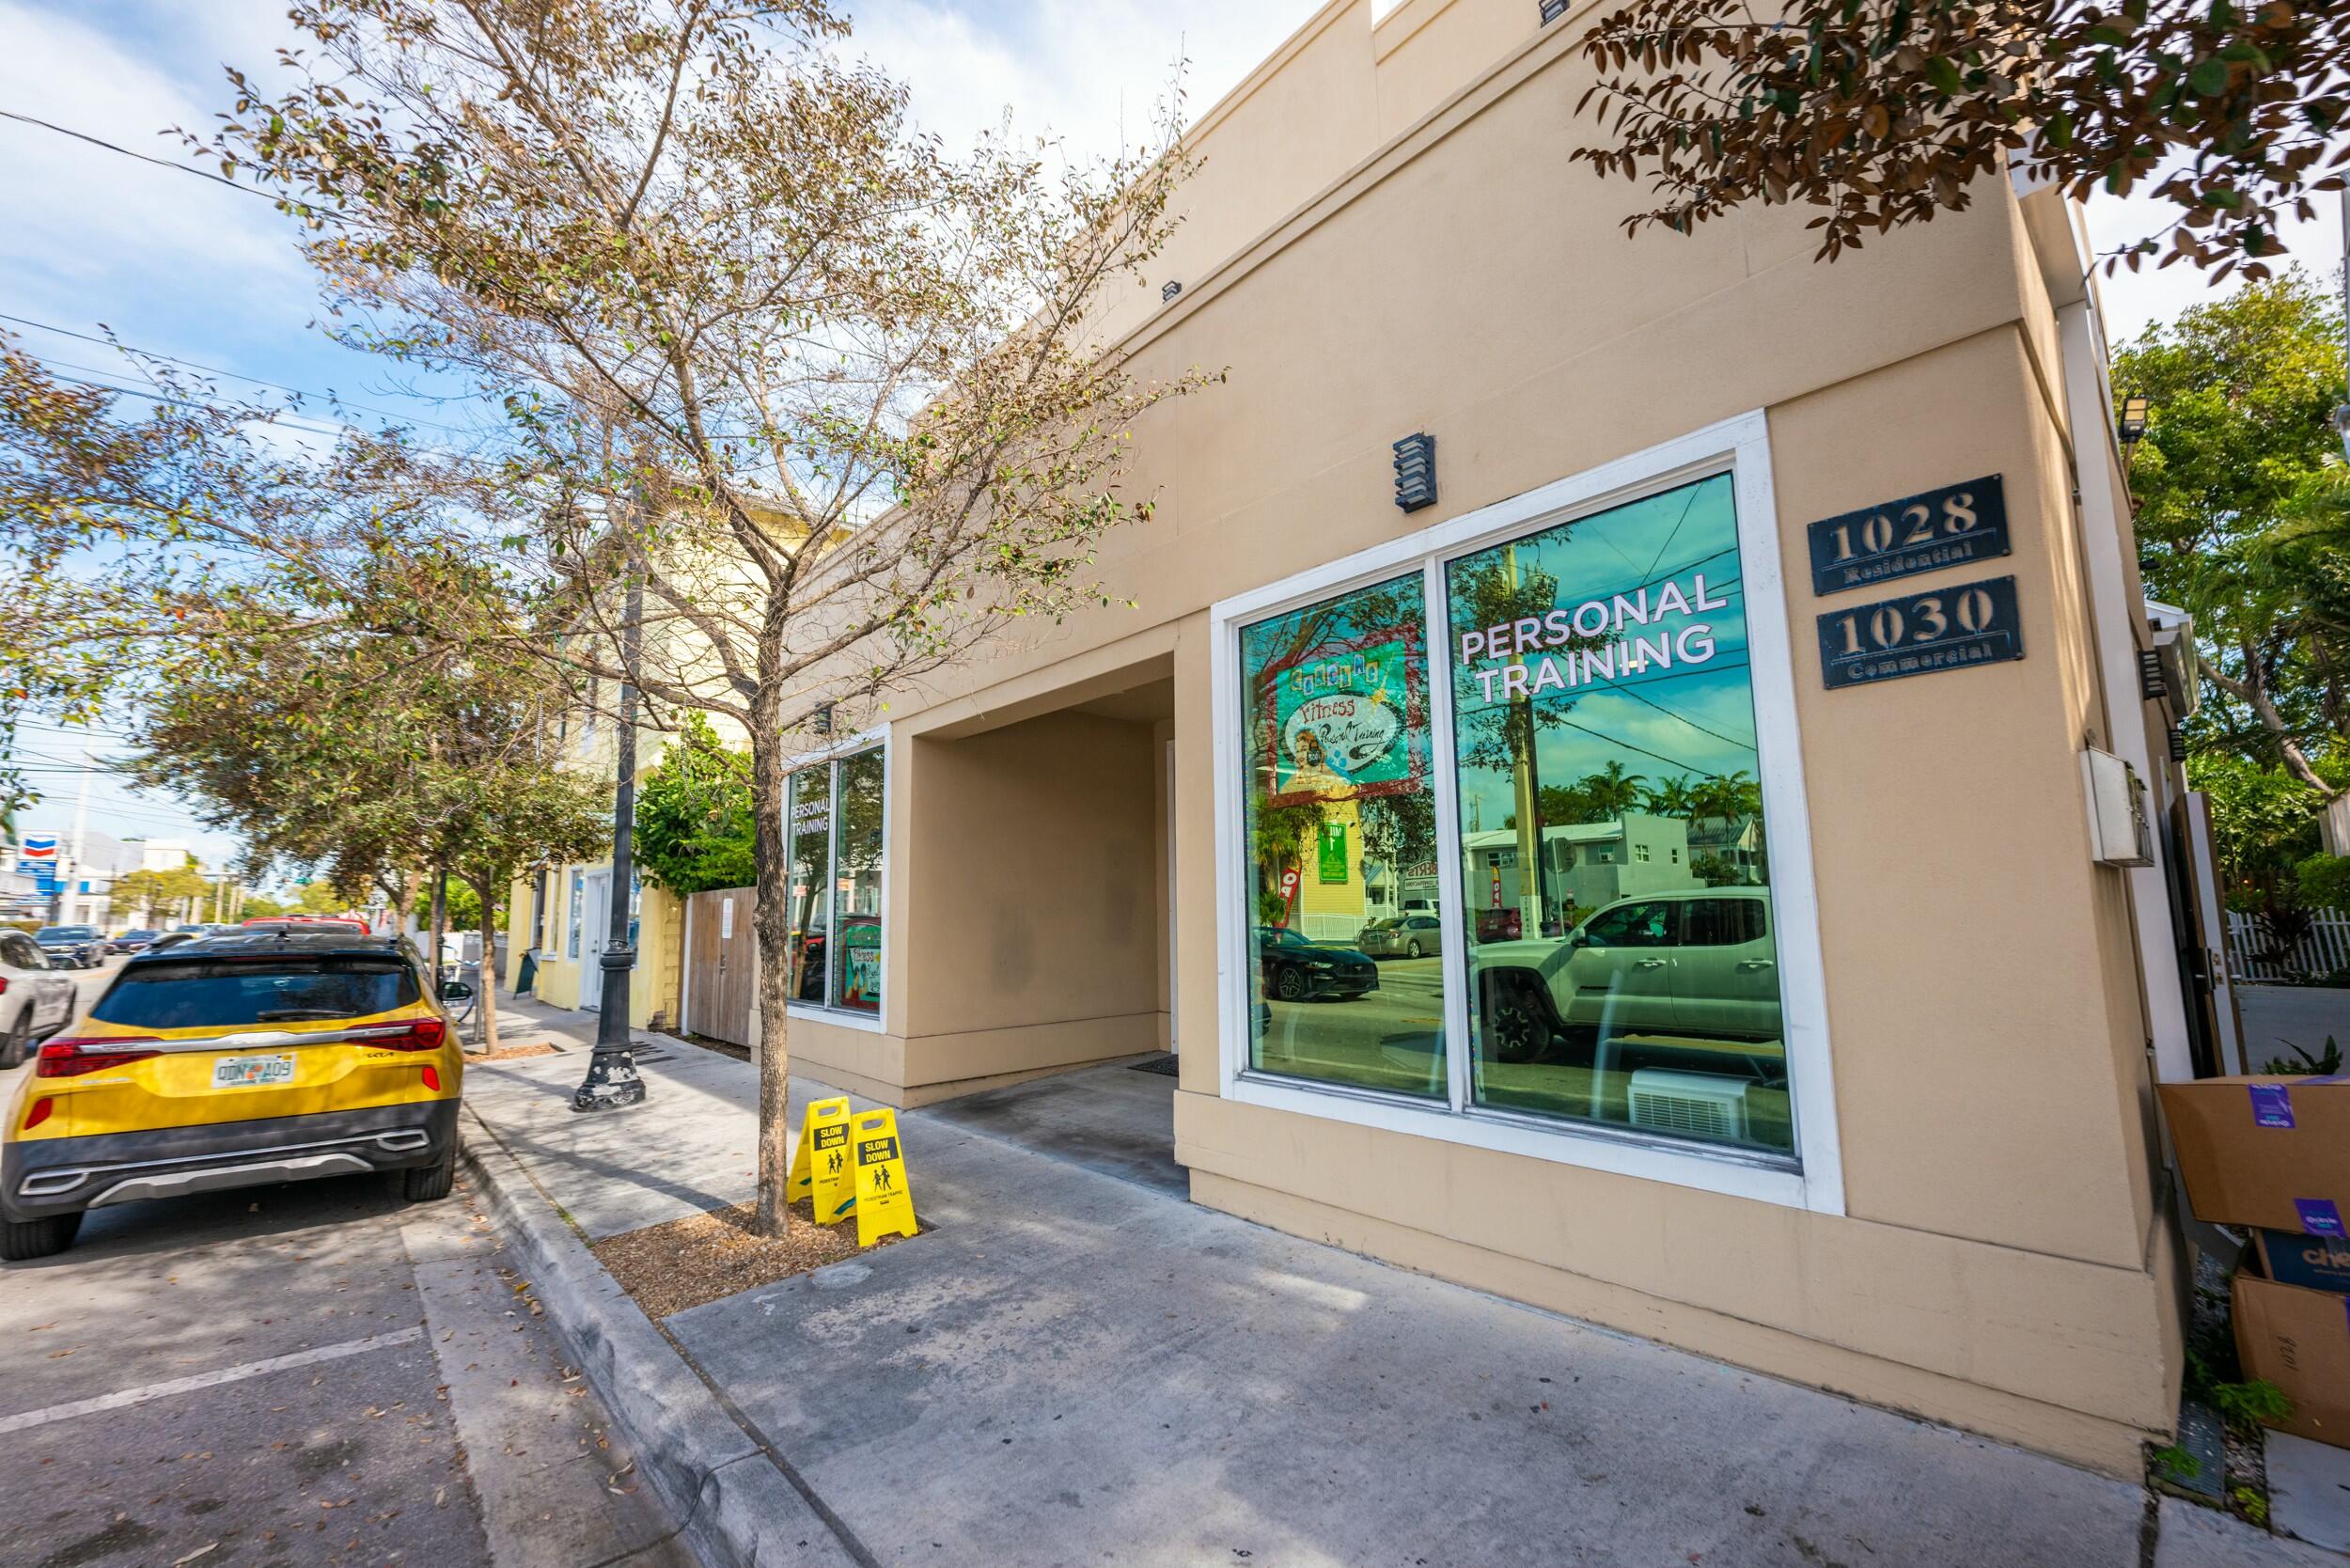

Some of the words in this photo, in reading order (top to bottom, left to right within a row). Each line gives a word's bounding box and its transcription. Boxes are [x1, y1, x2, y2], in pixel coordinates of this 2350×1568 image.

[1831, 493, 1977, 561] 1028
[1844, 541, 1973, 584] Residential
[1461, 573, 1728, 666] PERSONAL
[1836, 588, 1994, 657] 1030
[1475, 623, 1716, 703] TRAINING
[1848, 643, 1993, 679] Commercial
[791, 797, 831, 820] PERSONAL
[792, 816, 829, 837] TRAINING
[820, 1125, 843, 1138] SLOW
[821, 1135, 845, 1149] DOWN
[865, 1138, 889, 1152] SLOW
[866, 1150, 891, 1163] DOWN
